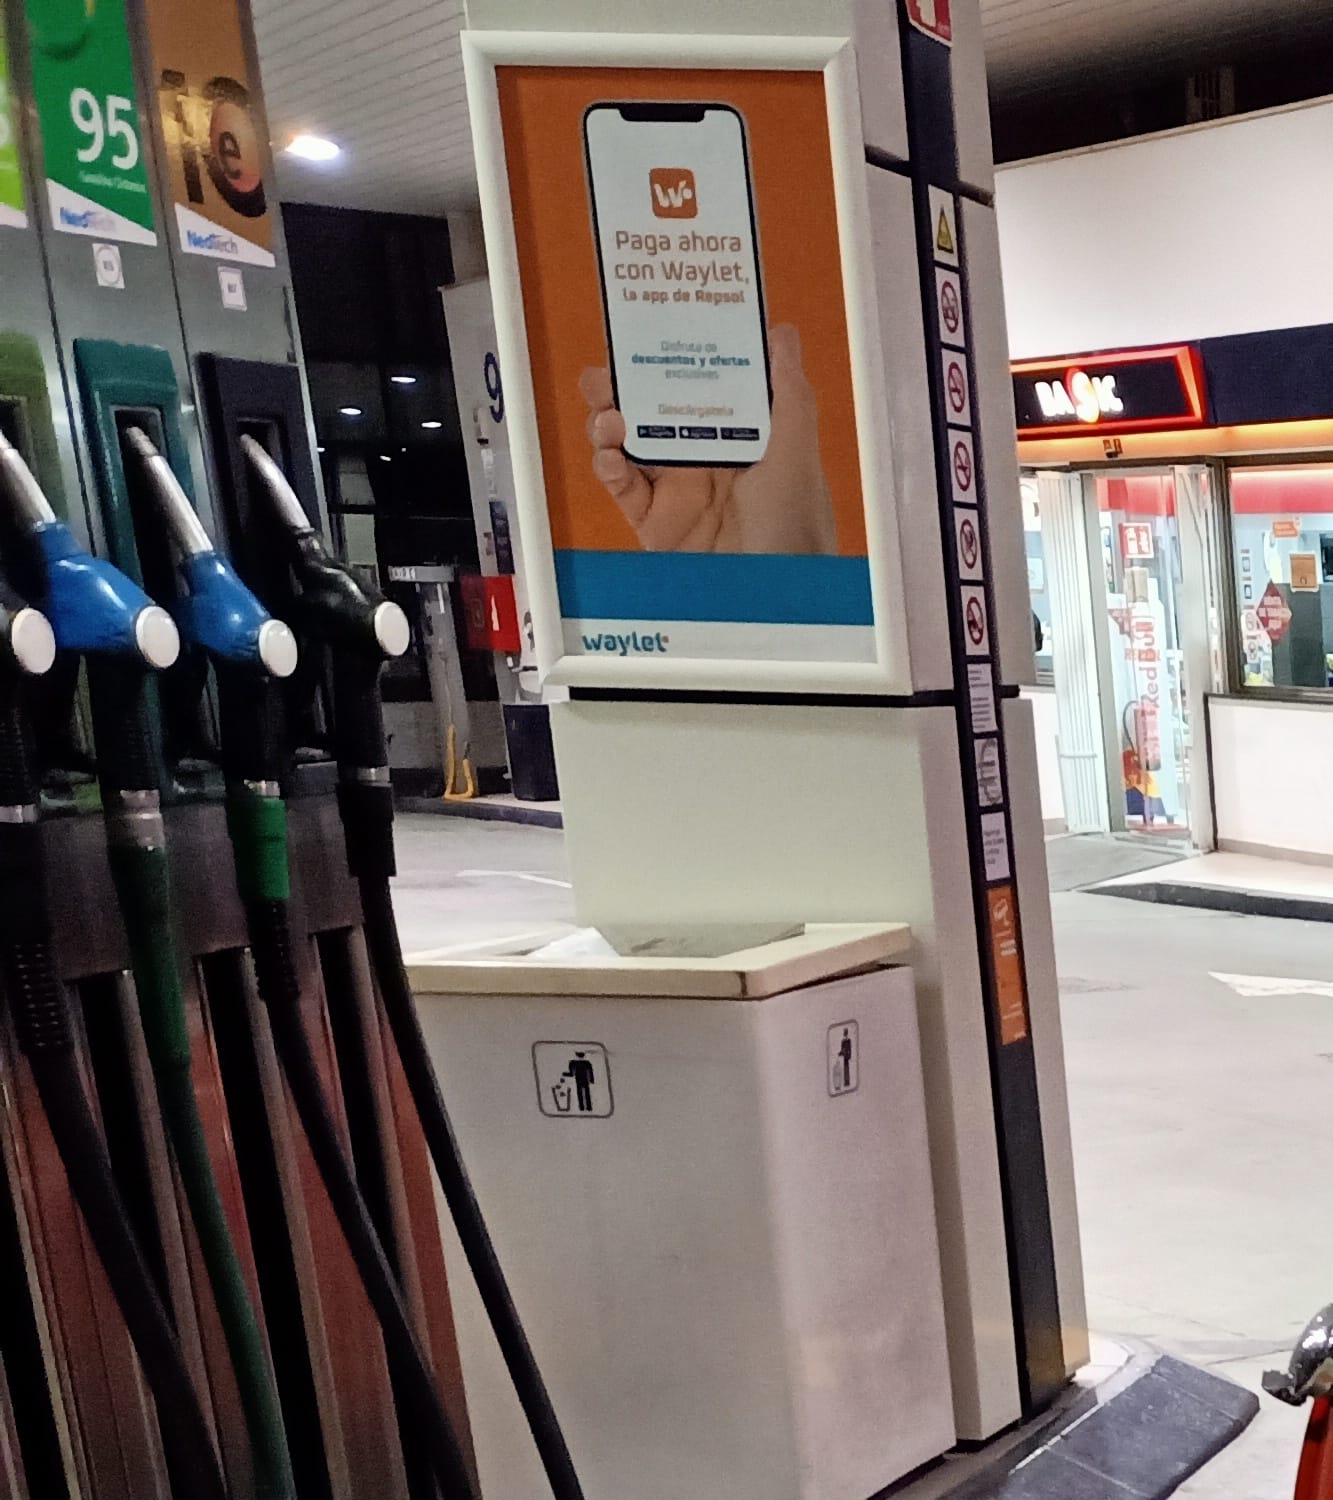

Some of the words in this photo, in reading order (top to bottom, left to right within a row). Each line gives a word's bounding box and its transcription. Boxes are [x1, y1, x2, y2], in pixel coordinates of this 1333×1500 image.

[70, 88, 138, 170] 95
[616, 230, 671, 256] Paga
[678, 230, 742, 252] ahora
[614, 263, 655, 280] con
[661, 260, 749, 287] Waylet,
[623, 287, 637, 301] la
[642, 290, 669, 304] app
[673, 288, 690, 303] de
[695, 289, 745, 306] Repsol
[582, 631, 667, 656] waylet
